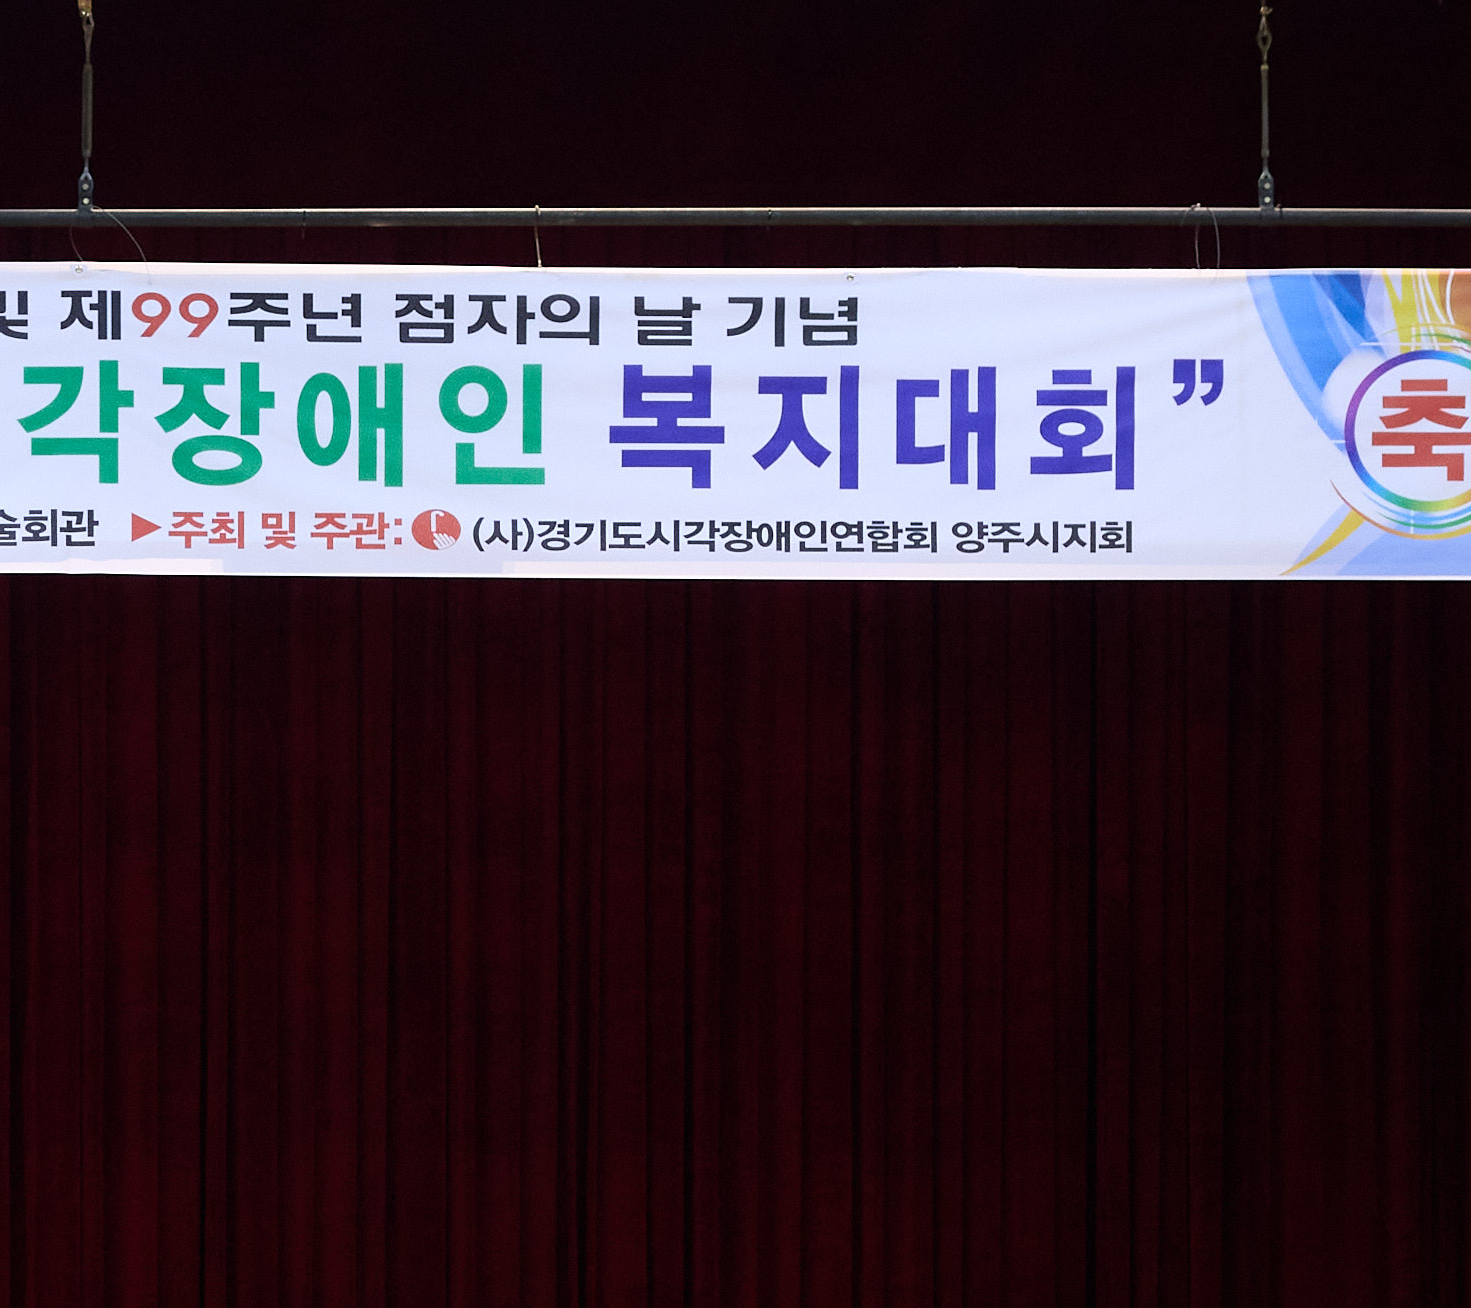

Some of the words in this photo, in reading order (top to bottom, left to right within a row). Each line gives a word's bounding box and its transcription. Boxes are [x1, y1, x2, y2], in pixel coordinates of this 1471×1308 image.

[60, 289, 363, 344] 제99주년
[394, 293, 601, 346] 점자의
[633, 295, 702, 347] 날
[726, 296, 859, 348] 기념
[168, 511, 245, 550] 주최
[261, 511, 297, 550] 및
[310, 511, 403, 550] 주관:
[472, 516, 938, 554] (사)경기도시각장애인연합회
[951, 520, 1133, 554] 양주시지회
